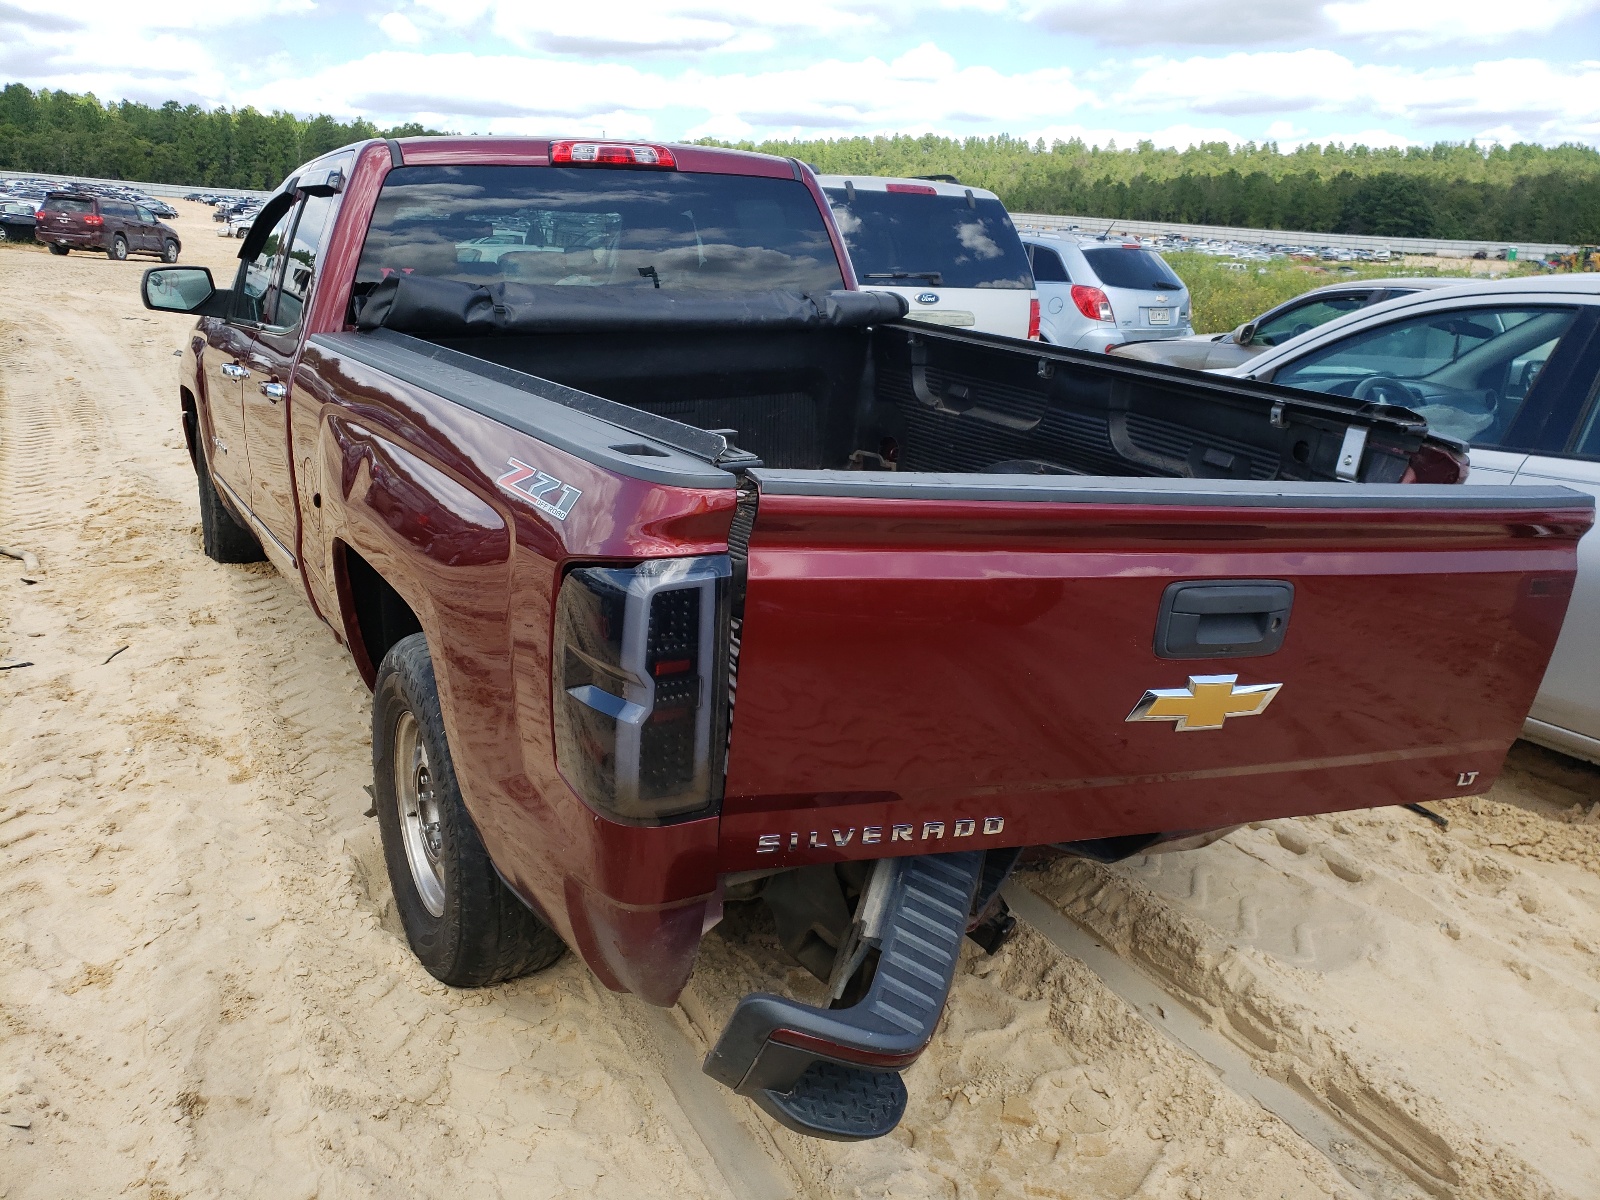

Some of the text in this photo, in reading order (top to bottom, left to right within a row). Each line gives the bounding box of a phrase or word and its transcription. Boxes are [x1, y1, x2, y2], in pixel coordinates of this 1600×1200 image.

[495, 456, 582, 520] Z71
[548, 506, 566, 519] ROAD
[1456, 771, 1480, 786] LT
[756, 816, 1005, 853] SILVERADO
